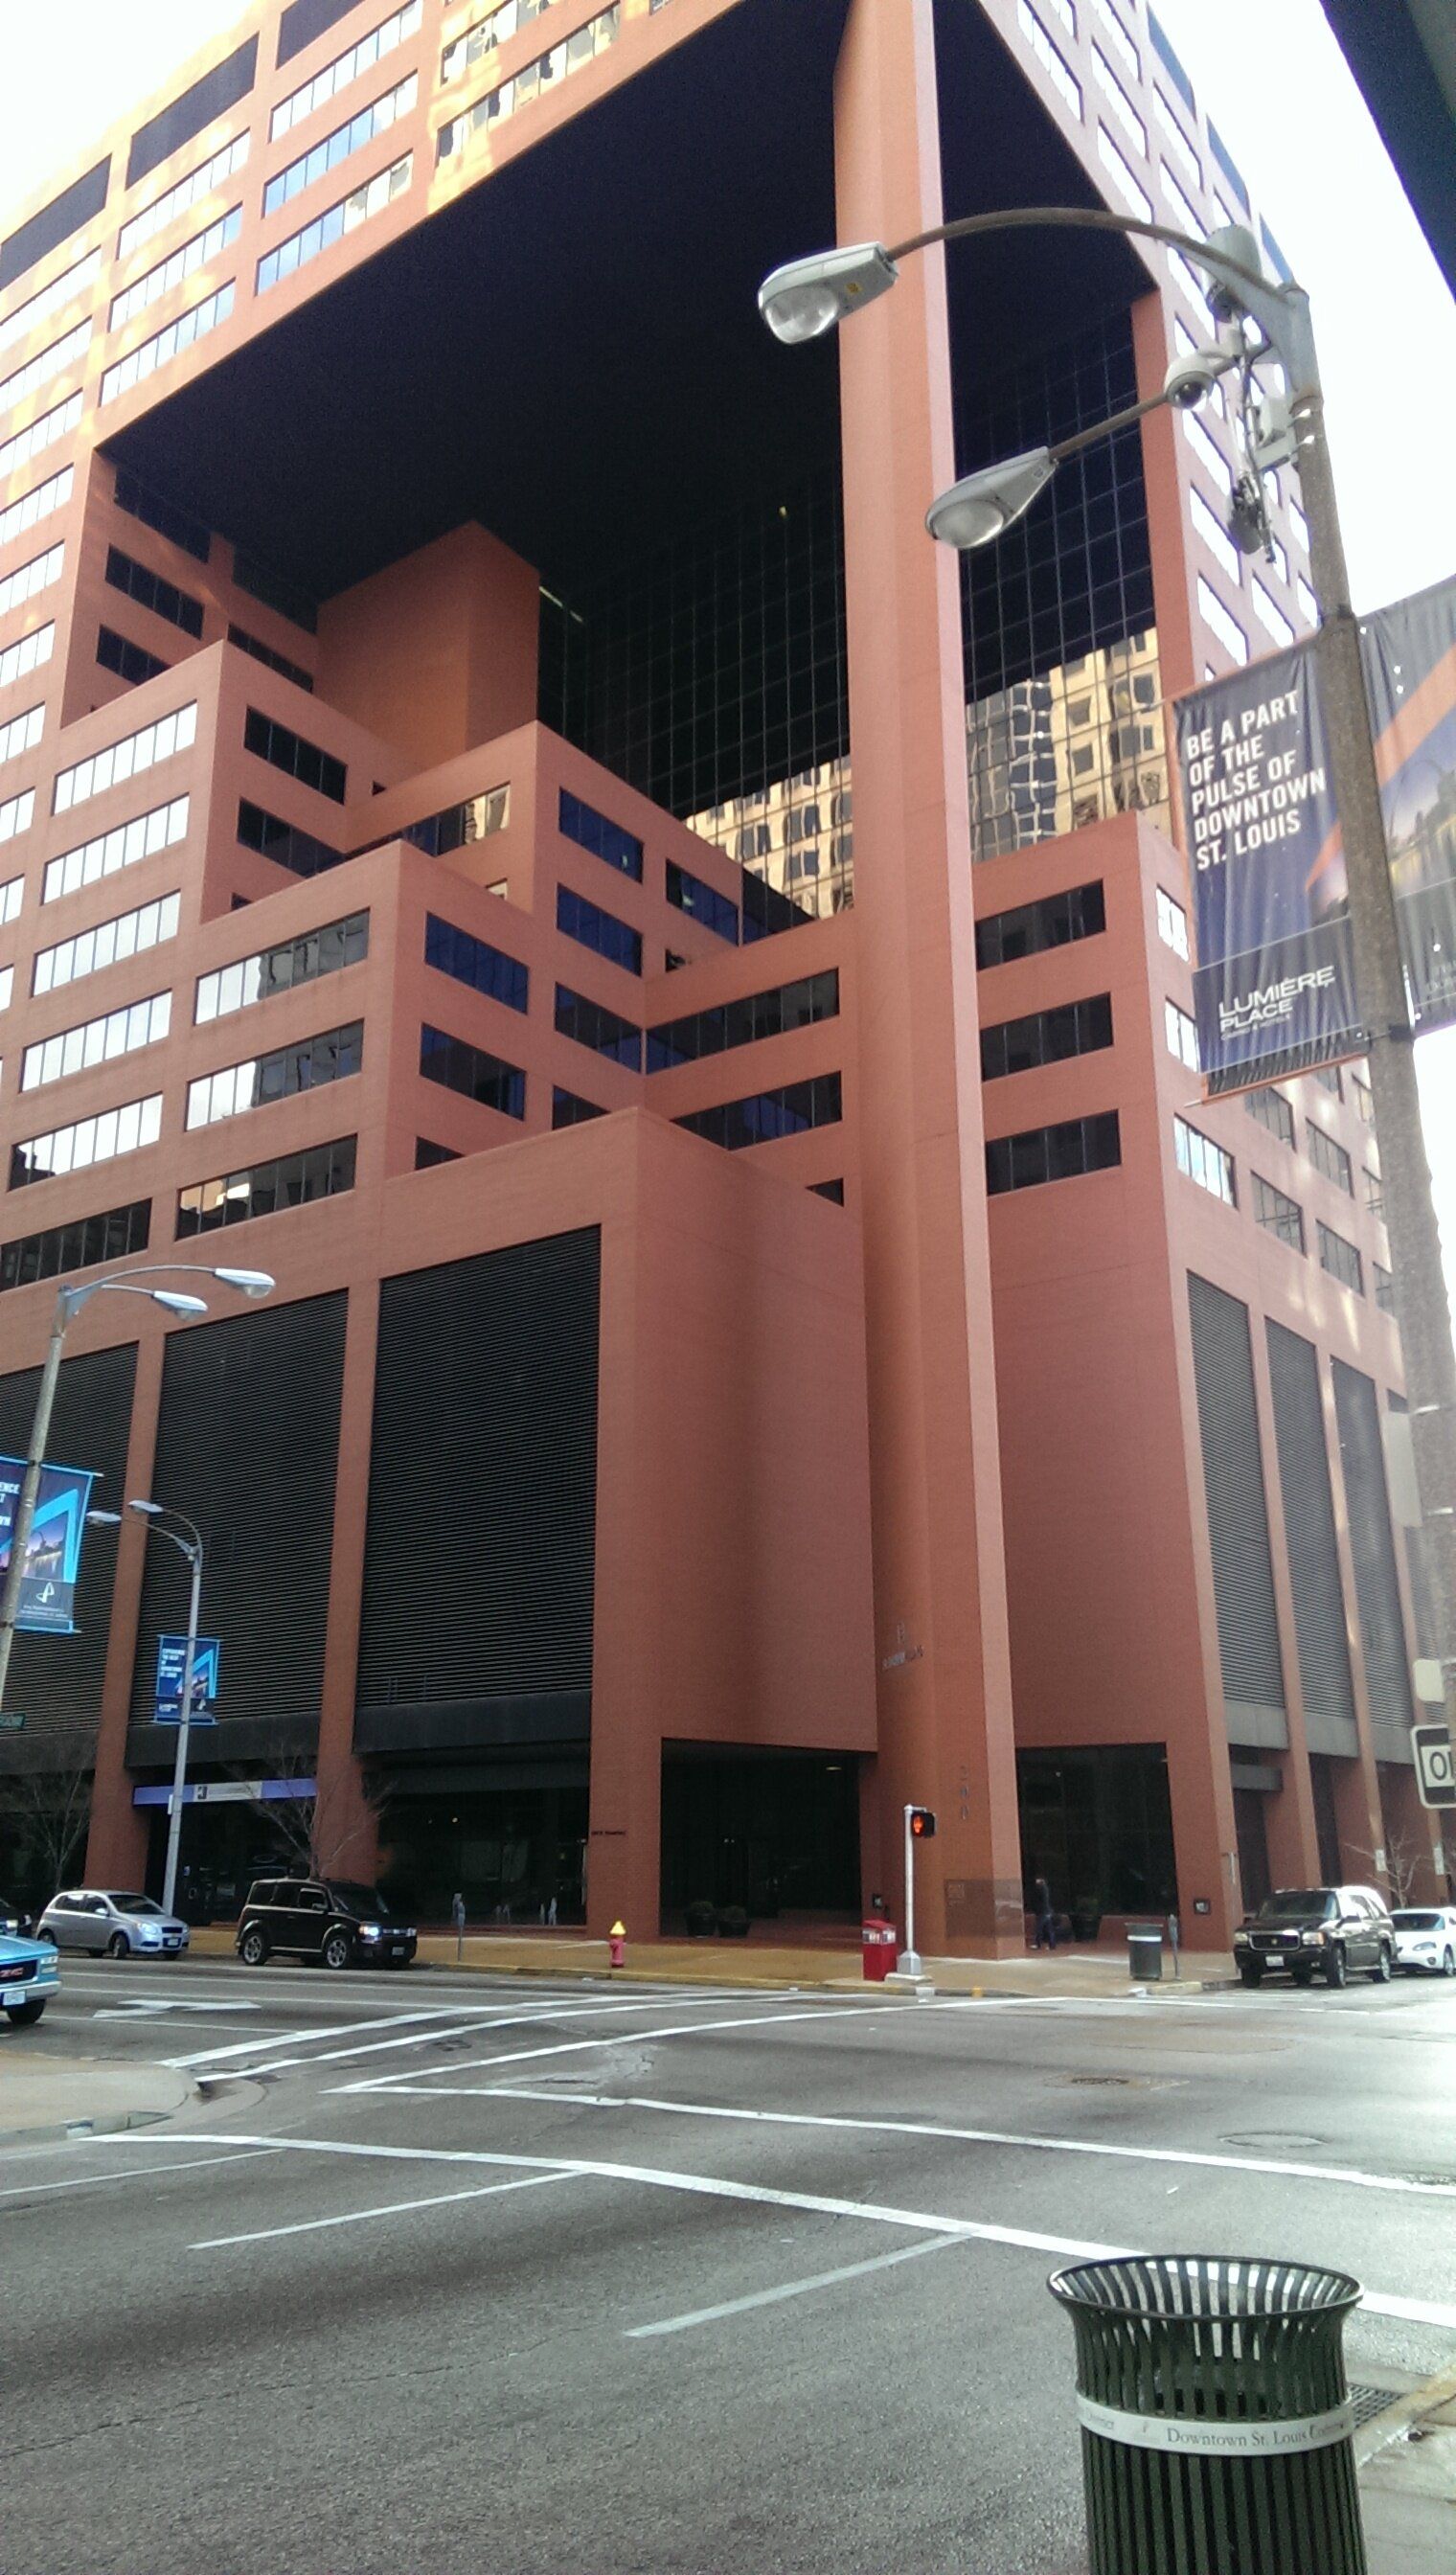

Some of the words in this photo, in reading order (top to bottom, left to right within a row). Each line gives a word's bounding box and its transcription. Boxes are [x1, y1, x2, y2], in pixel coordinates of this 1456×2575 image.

[1187, 728, 1214, 760] BE
[1220, 719, 1236, 745] A
[1240, 690, 1298, 735] PART
[1189, 755, 1215, 786] OF
[1221, 735, 1264, 771] THE
[1192, 765, 1261, 814] PULSE
[1267, 750, 1297, 781] OF
[1194, 767, 1326, 843] DOWNTOWN
[1196, 839, 1227, 870] ST.
[1235, 809, 1301, 855] LOUIS
[1220, 997, 1293, 1033] PLACE
[1167, 2427, 1247, 2447] Downtown
[1273, 2430, 1307, 2445] Louis
